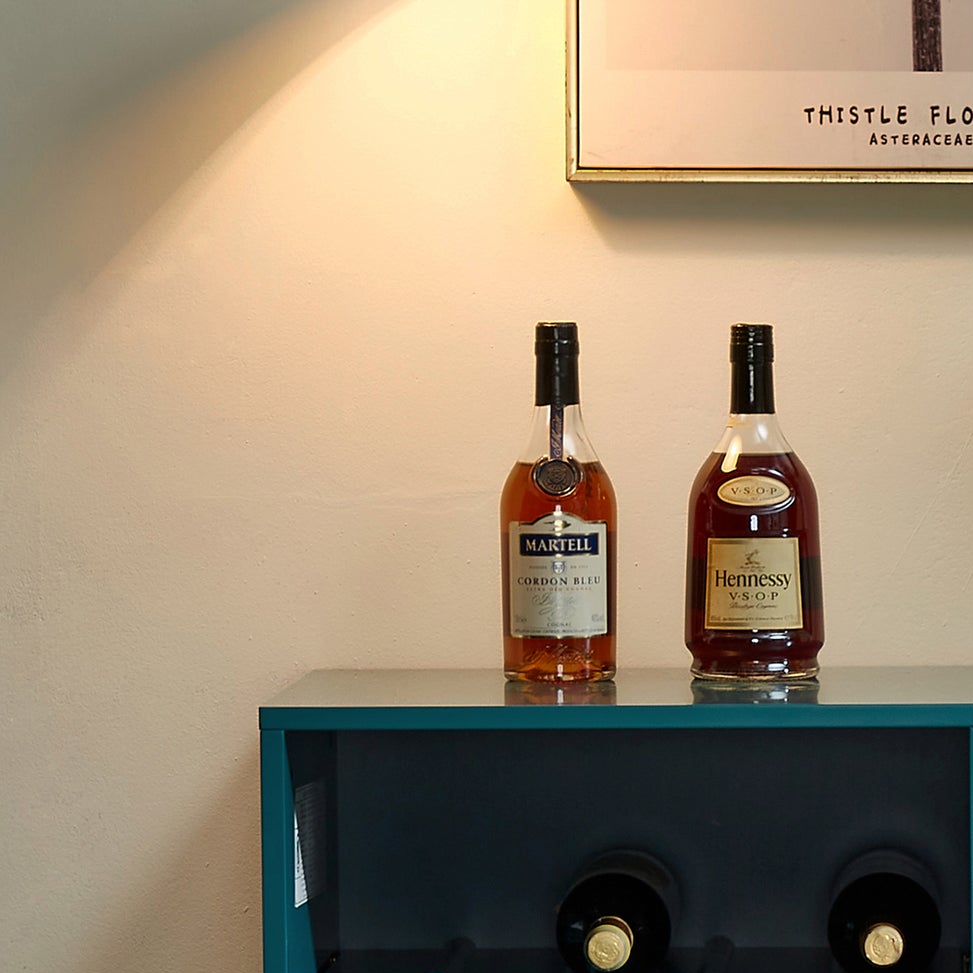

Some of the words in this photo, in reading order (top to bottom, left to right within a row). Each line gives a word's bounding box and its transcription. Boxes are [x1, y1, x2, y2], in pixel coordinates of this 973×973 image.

[804, 105, 908, 125] THISTLE
[869, 132, 973, 146] ASTERACEAE
[525, 538, 592, 551] MARTELL
[517, 576, 568, 586] CORDON
[573, 576, 601, 585] BLEU
[715, 569, 792, 590] Hennessy
